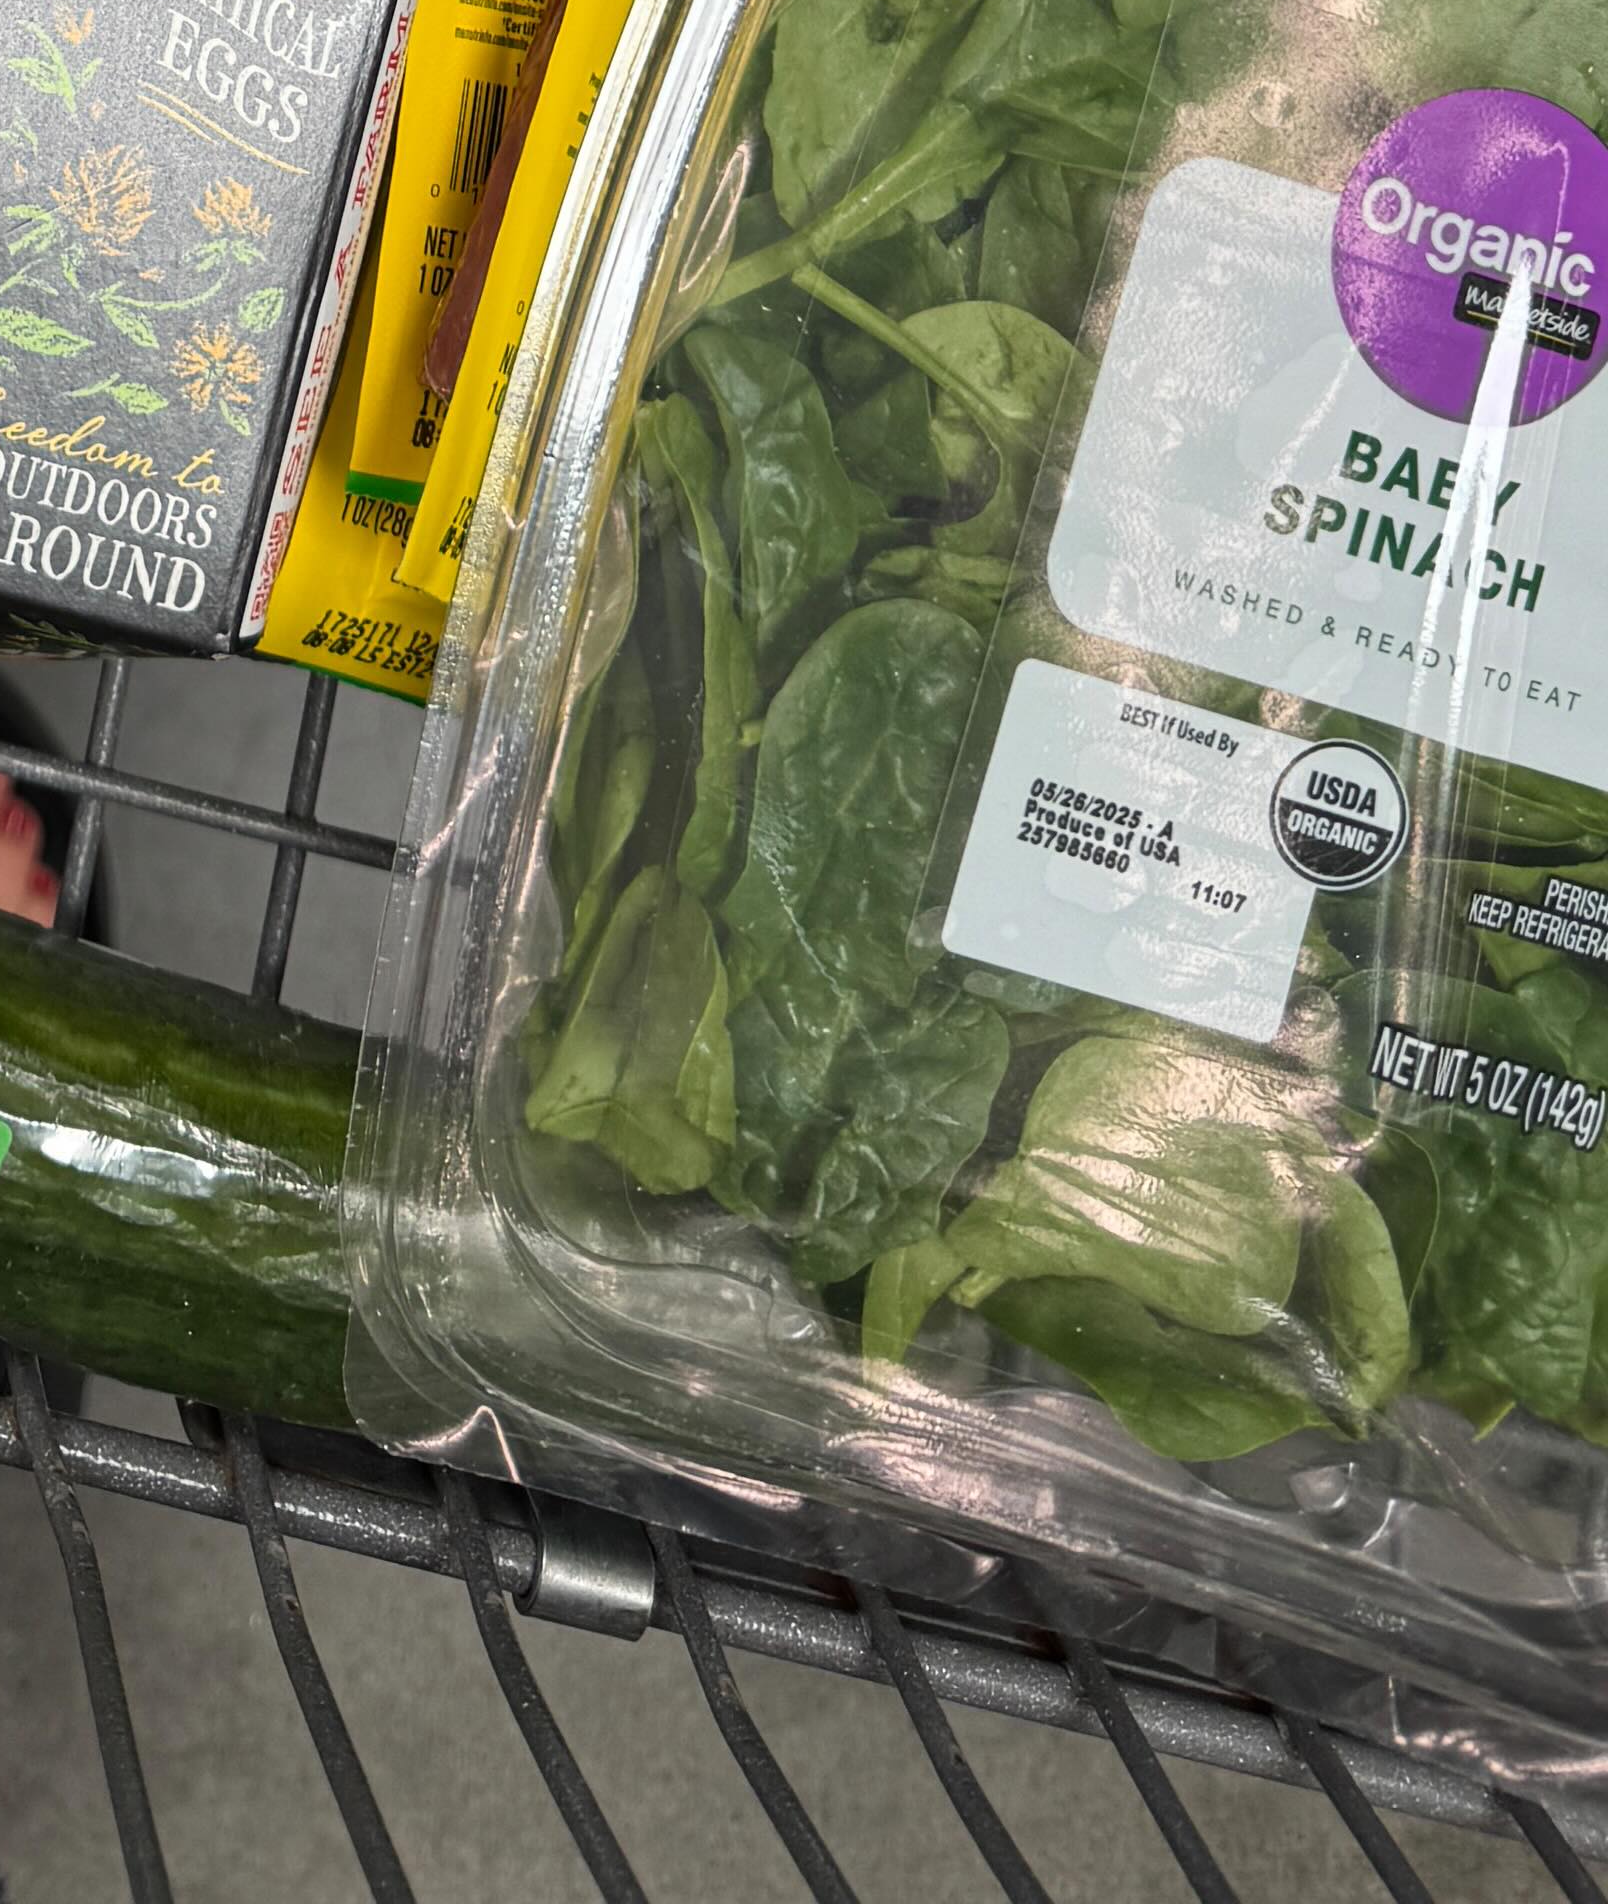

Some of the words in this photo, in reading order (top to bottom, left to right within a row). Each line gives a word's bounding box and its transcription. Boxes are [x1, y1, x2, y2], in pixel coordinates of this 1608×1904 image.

[158, 7, 307, 144] EGGS
[1362, 176, 1595, 298] Organic
[173, 447, 226, 495] to
[0, 518, 207, 615] ROUND
[1264, 483, 1546, 612] SPINACH
[1173, 568, 1303, 626] WASHED
[1354, 624, 1463, 679] READY
[1483, 665, 1512, 691] TO
[1526, 678, 1583, 712] EAT
[1119, 701, 1158, 733] BEST
[1178, 718, 1215, 749] Used
[1218, 731, 1239, 758] By
[1029, 776, 1141, 833] 05/26/2025
[1306, 768, 1379, 819] USDA
[1023, 797, 1105, 843] Produce
[1138, 832, 1181, 867] USA
[1286, 807, 1379, 857] ORGANIC
[1190, 879, 1248, 913] 11:07
[1468, 893, 1512, 929] KEEP
[1433, 1047, 1468, 1098] WT
[1466, 1056, 1490, 1104] 5
[1488, 1060, 1528, 1116] OZ
[1525, 1071, 1606, 1149] (142g)
